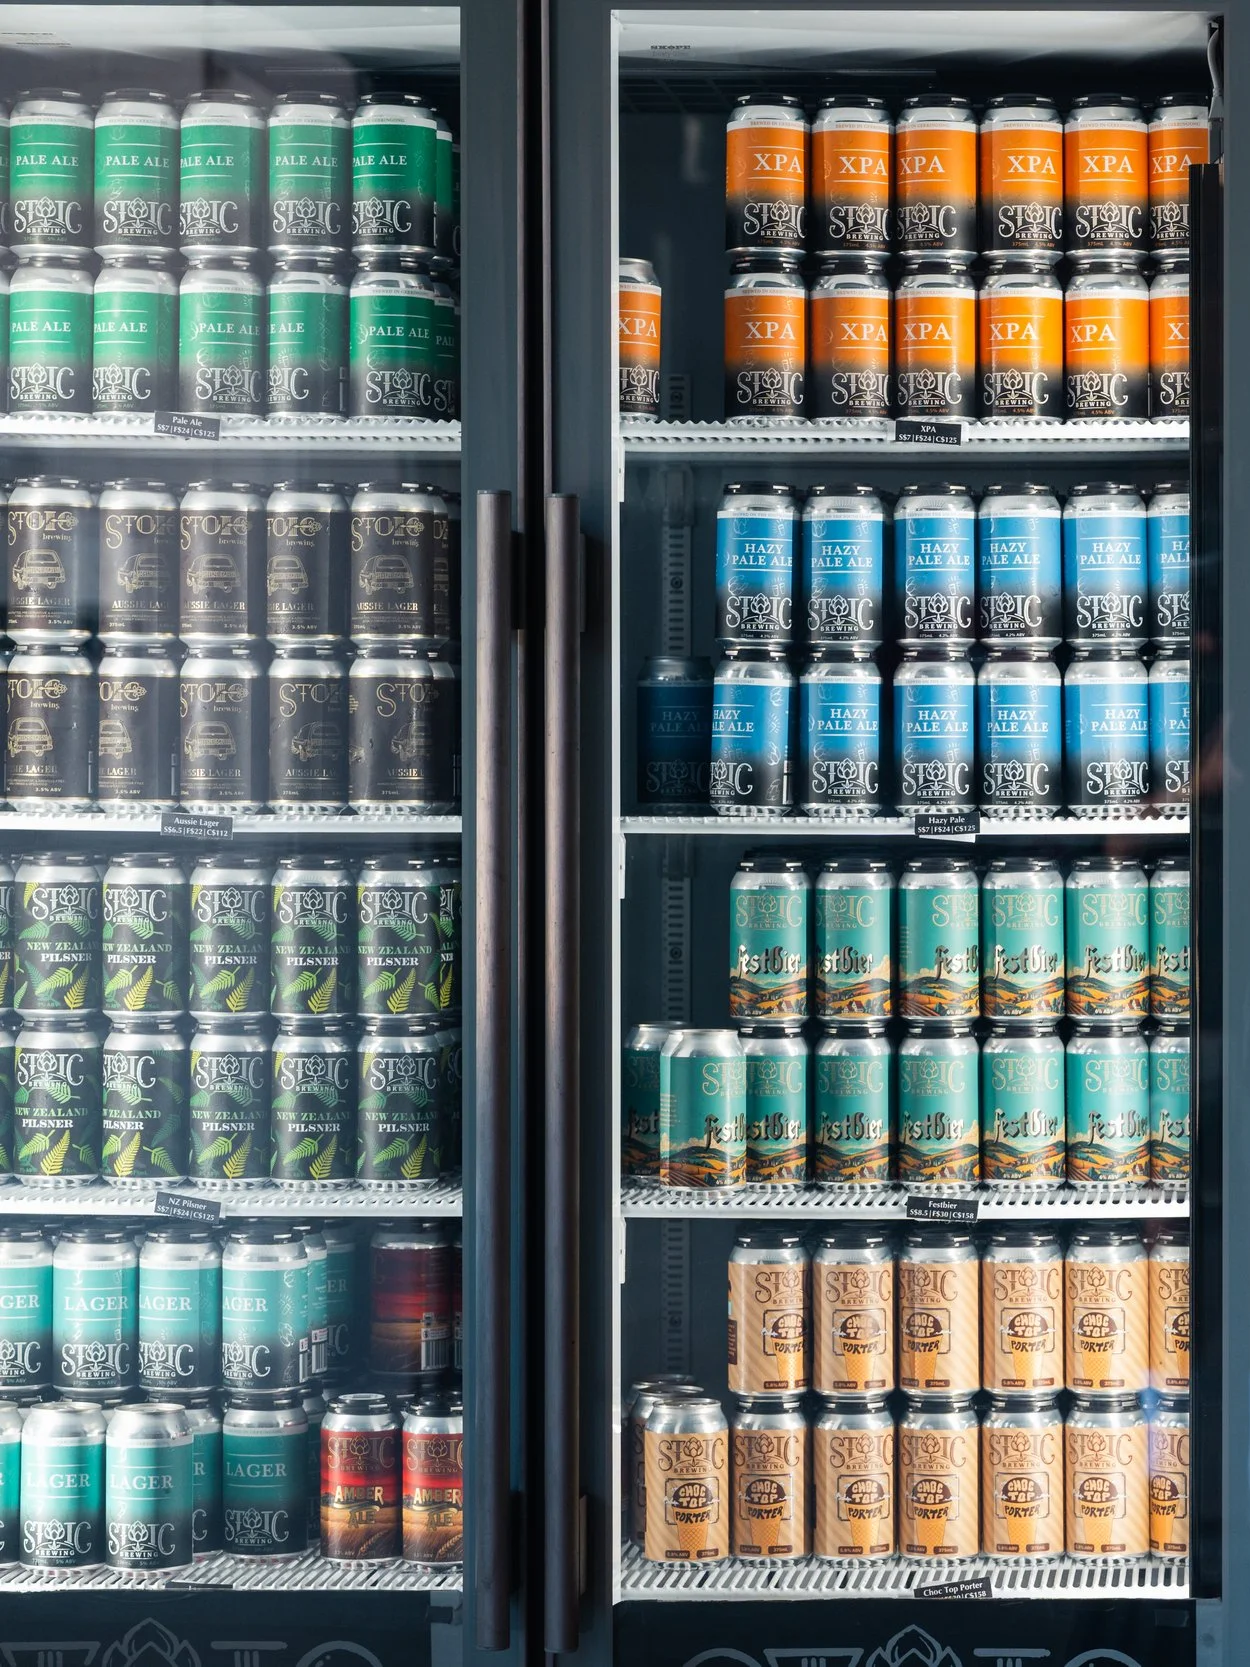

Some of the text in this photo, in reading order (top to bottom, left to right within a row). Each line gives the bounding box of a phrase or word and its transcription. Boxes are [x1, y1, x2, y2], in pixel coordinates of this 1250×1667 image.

[16, 155, 79, 167] PALE ALE
[105, 155, 170, 168] PALE ALE
[1007, 155, 1056, 175] XPA
[1083, 155, 1134, 173] XPA
[172, 416, 188, 425] Pale
[920, 425, 937, 433] XPA
[920, 543, 960, 554] HAZY
[1092, 542, 1132, 553] HAZY
[907, 555, 970, 566] PALE ALE
[1079, 554, 1142, 565] PALE ALE
[111, 600, 146, 609] AUSSIE
[387, 602, 418, 611] LAGER
[174, 817, 220, 828] Aussie Lager
[928, 817, 948, 825] Hazy
[275, 945, 296, 954] NEW
[378, 946, 432, 955] ZEALAND
[286, 957, 339, 966] PILSNER
[168, 1197, 207, 1210] NZ Pilsner
[928, 1201, 958, 1209] Festbier
[63, 1296, 129, 1311] LAGER
[1082, 1314, 1110, 1327] CHOC
[1082, 1326, 1110, 1338] TOP
[1080, 1339, 1116, 1353] PORTER
[226, 1462, 288, 1478] LAGER
[26, 1473, 91, 1488] LAGER
[333, 1485, 384, 1505] AMBER
[348, 1510, 376, 1529] ALE
[923, 1589, 943, 1597] Choc
[944, 1586, 959, 1594] Top
[960, 1582, 983, 1591] Porter
